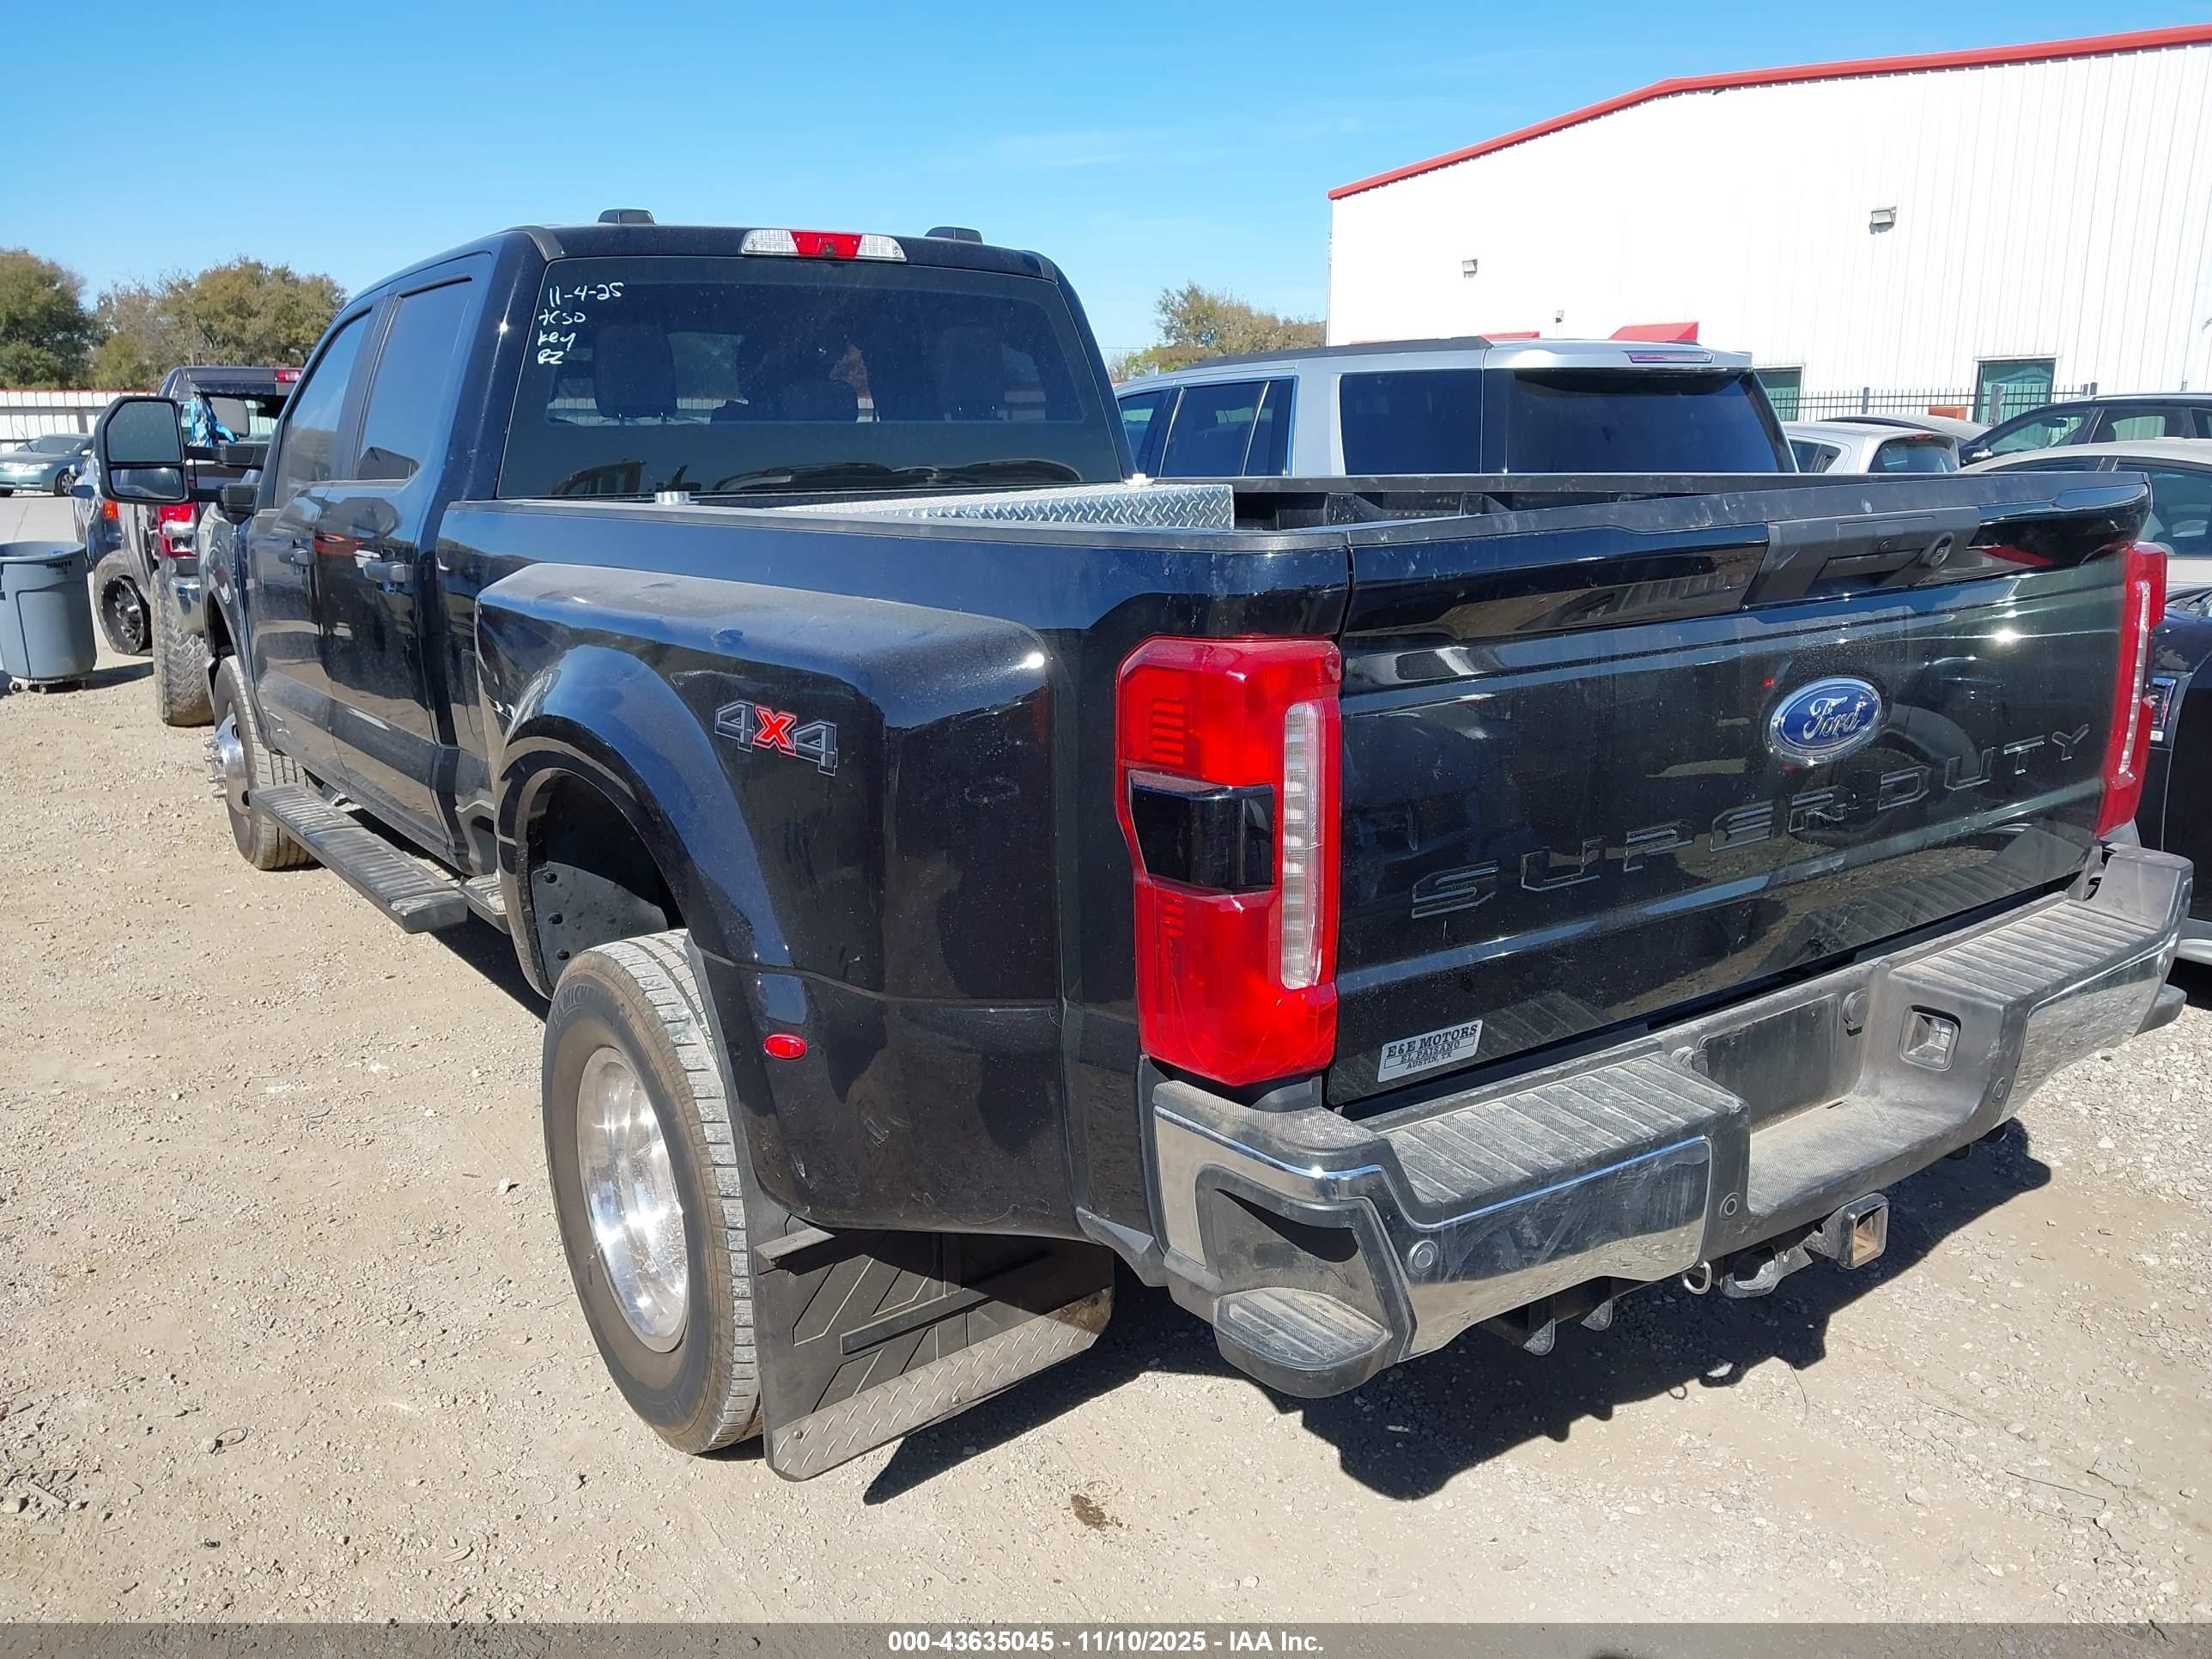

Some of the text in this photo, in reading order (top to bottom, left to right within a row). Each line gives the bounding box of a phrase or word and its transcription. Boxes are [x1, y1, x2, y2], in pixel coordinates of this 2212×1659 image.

[550, 282, 624, 307] 11-4-25
[1802, 695, 1868, 741] Ford
[1411, 723, 2089, 919] SUPER DUTY
[1387, 1024, 1478, 1059] E&E MOTORS
[1400, 1040, 1461, 1064] EL PAISANO
[1442, 1050, 1453, 1060] TX
